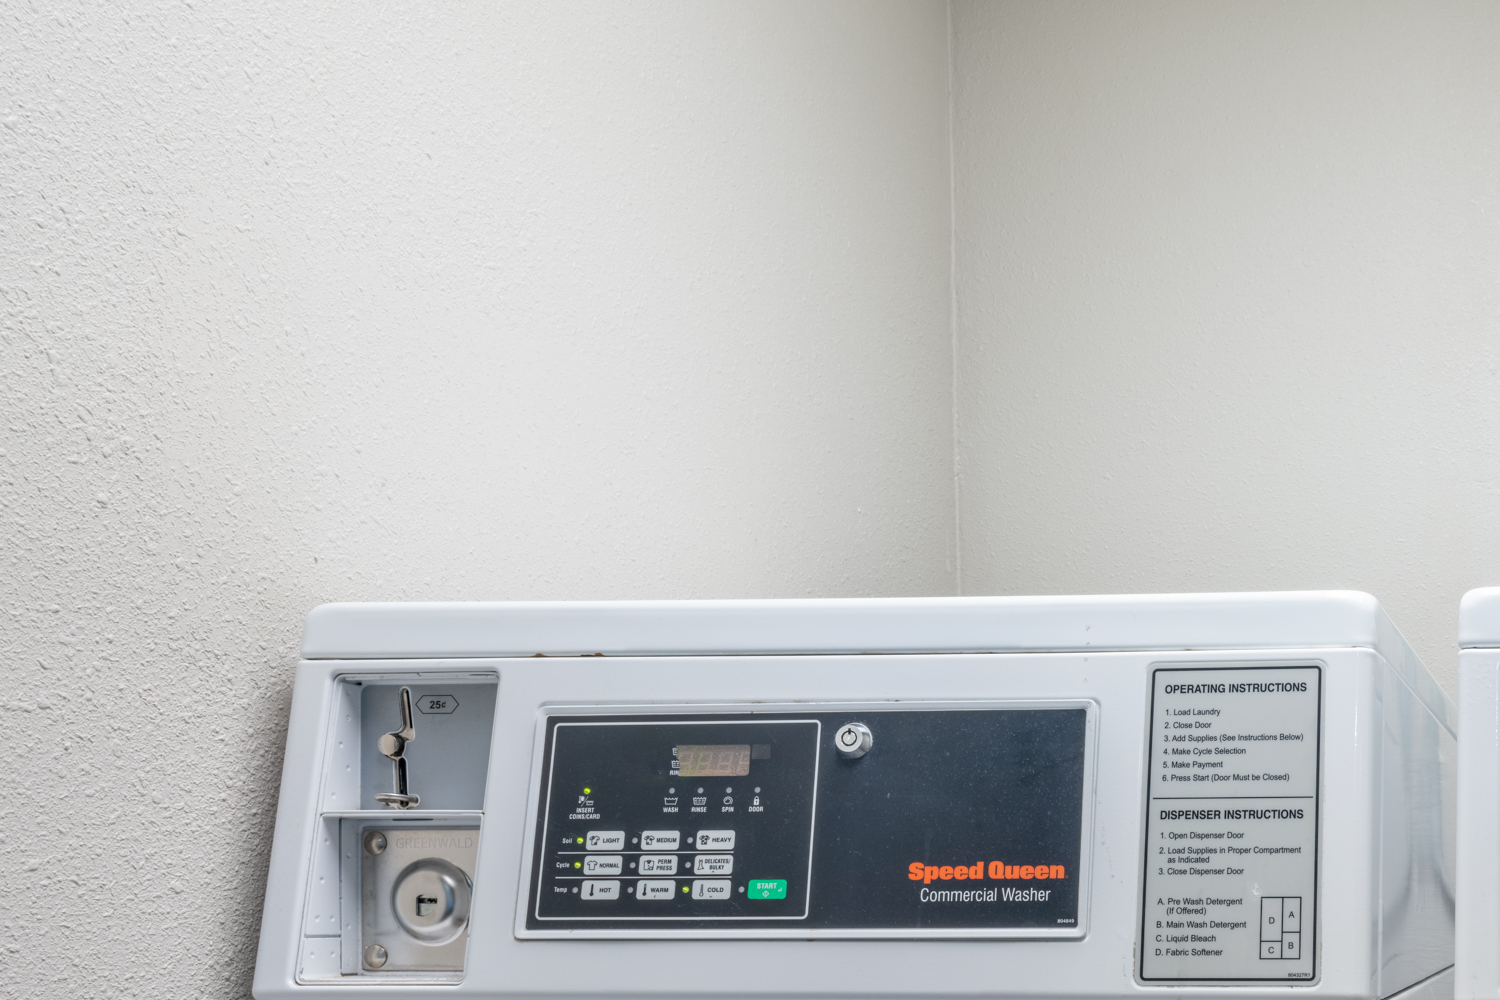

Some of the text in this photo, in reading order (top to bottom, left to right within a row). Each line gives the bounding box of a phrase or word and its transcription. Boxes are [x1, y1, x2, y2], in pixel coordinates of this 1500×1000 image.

[1165, 682, 1307, 694] OPERATING INSTRUCTIONS
[1193, 708, 1220, 716] Laundry
[1188, 734, 1217, 743] Supplies
[1220, 734, 1236, 742] (See
[1193, 748, 1212, 756] Cycle
[1192, 761, 1223, 769] Payment
[1211, 774, 1231, 782] (Door
[1262, 774, 1289, 782] Closed)
[1160, 809, 1304, 820] DISPENSER INSTRUCTIONS
[1168, 832, 1188, 840] Open
[1190, 832, 1225, 840] Dispenser
[396, 837, 473, 849] GREENWALD
[1188, 847, 1217, 855] Supplies
[1228, 846, 1251, 855] Proper
[1253, 846, 1301, 855] Compartment
[908, 861, 1064, 884] Speed Queen
[1190, 868, 1225, 876] Dispenser
[920, 888, 1051, 902] Commercial Washer
[1206, 898, 1242, 906] Detergent
[1176, 907, 1206, 916] Offered)
[1210, 921, 1246, 930] Detergent
[1166, 935, 1188, 943] Liquid
